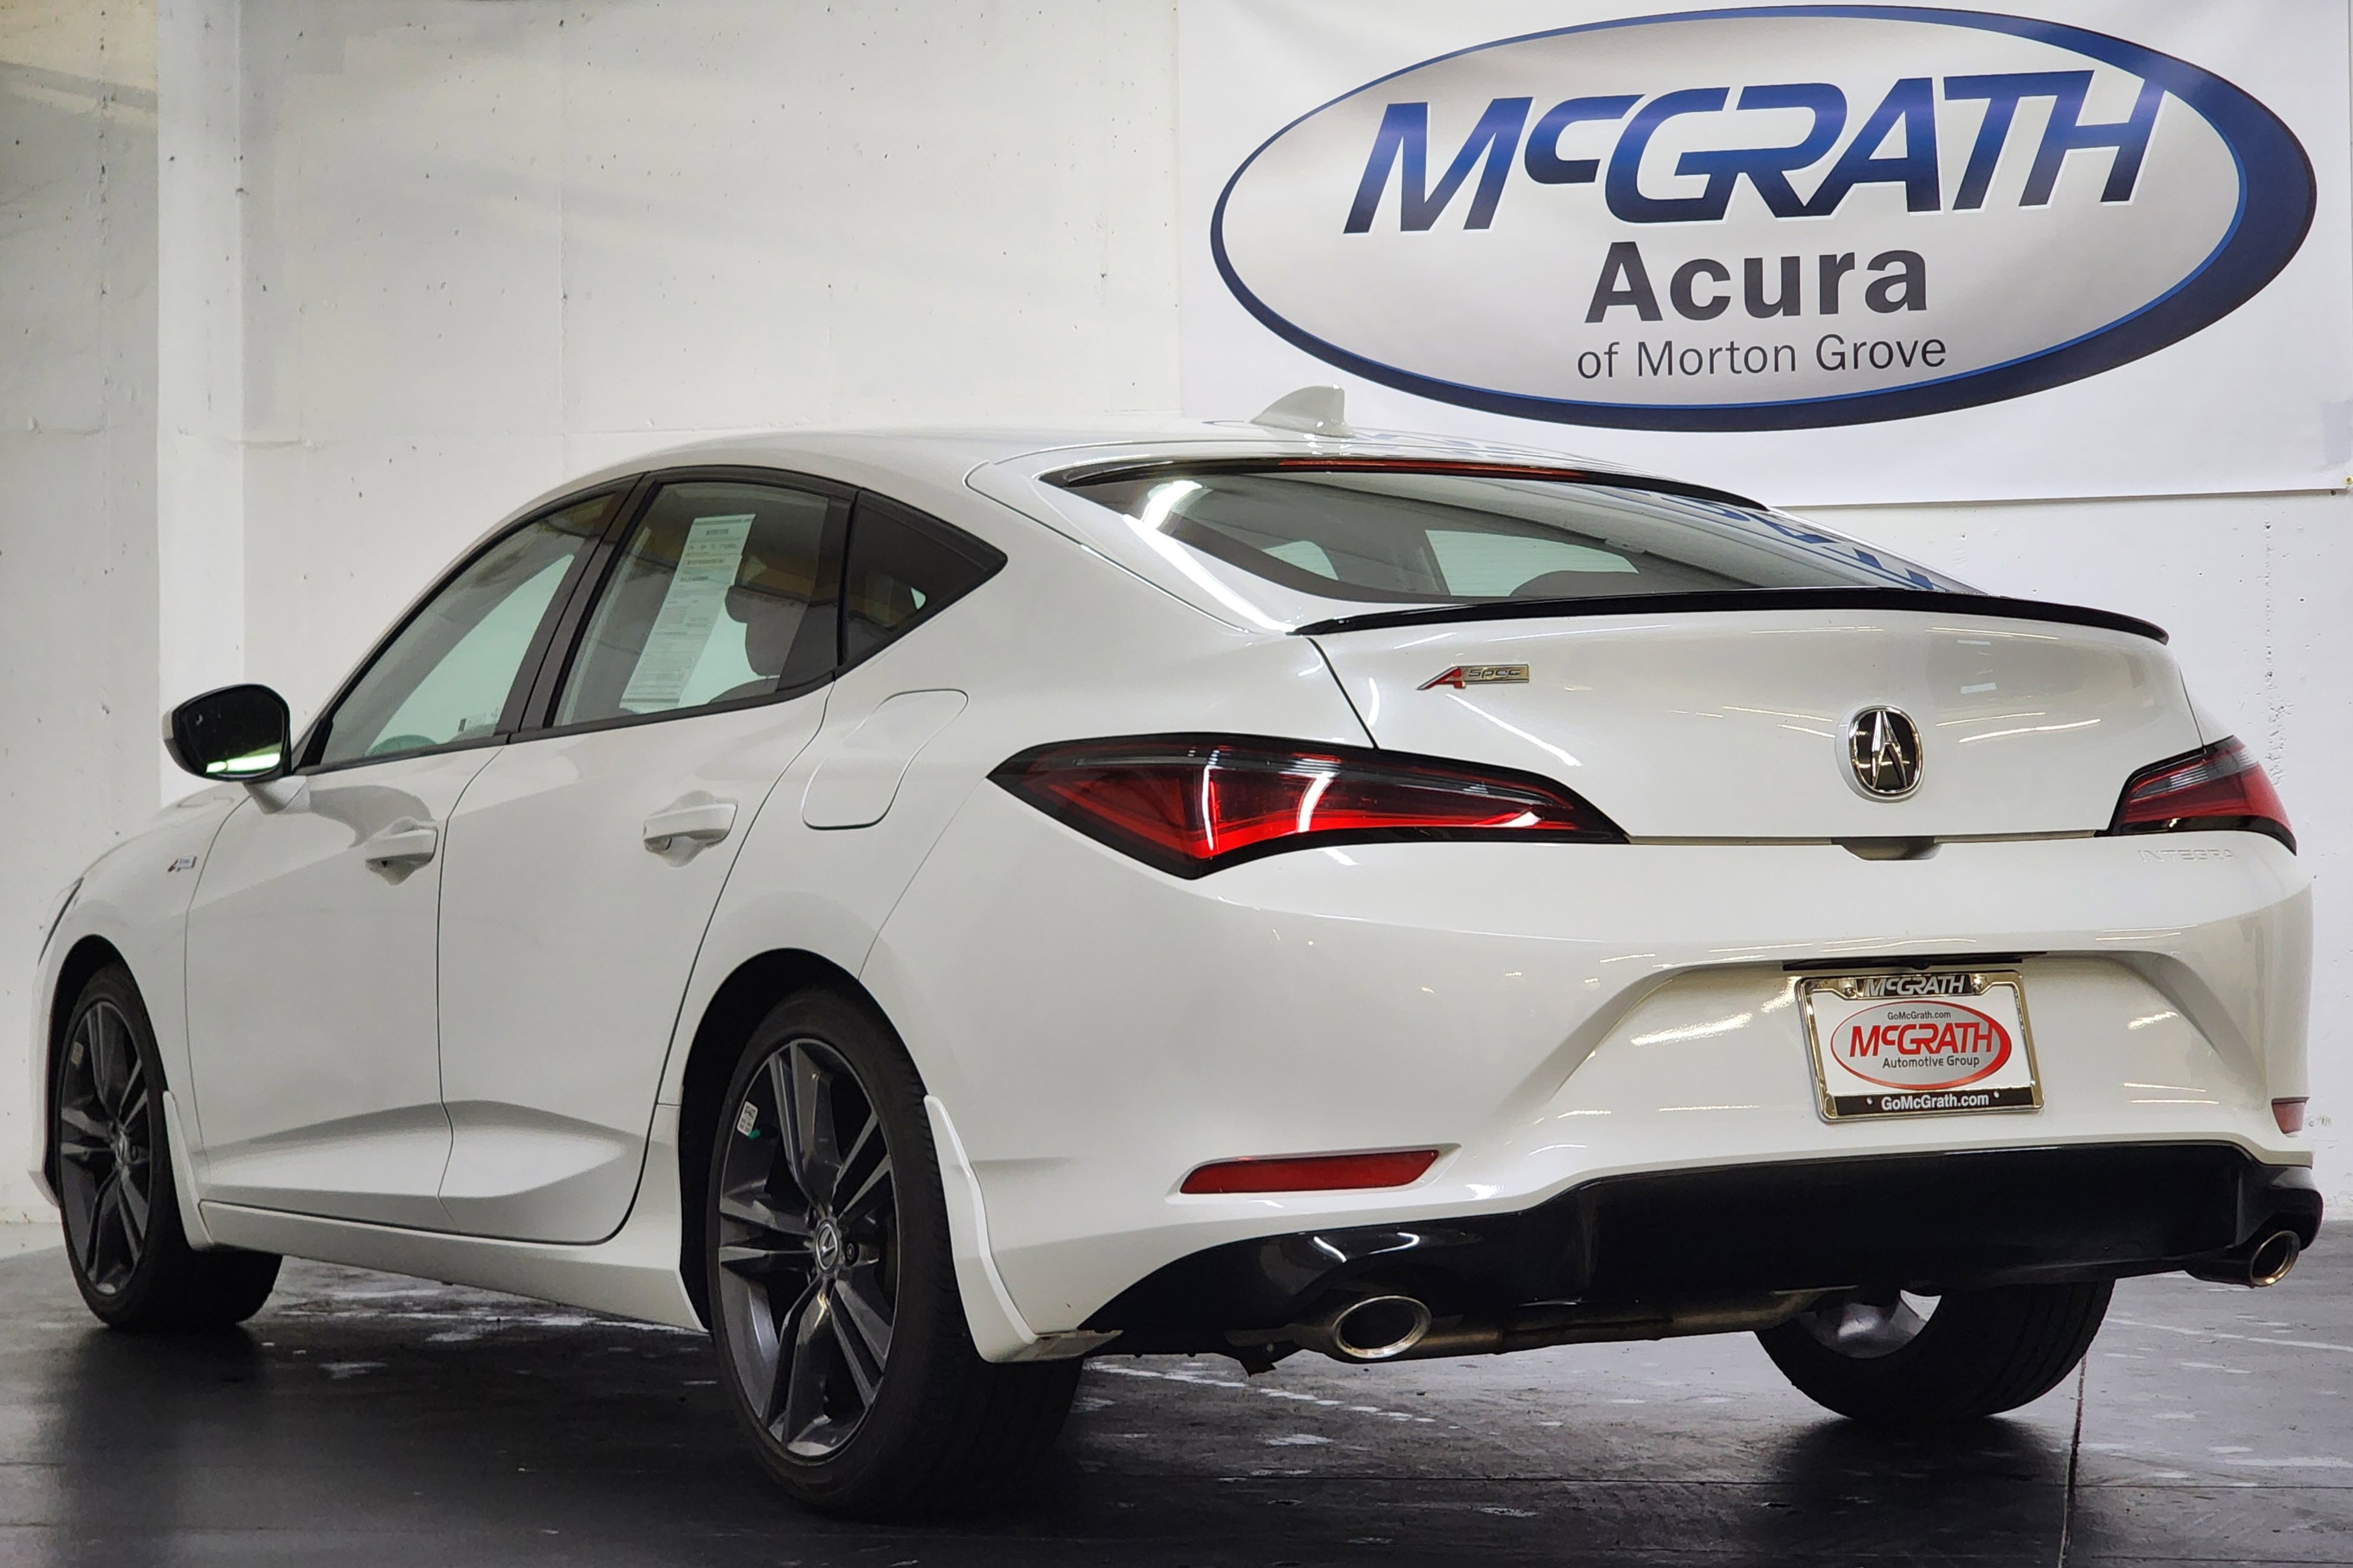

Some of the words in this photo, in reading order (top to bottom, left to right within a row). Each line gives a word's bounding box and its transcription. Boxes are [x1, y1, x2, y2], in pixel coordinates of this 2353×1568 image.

[1584, 241, 1928, 323] Acura
[1577, 341, 1620, 379] of
[1637, 340, 1797, 377] Morton
[1815, 334, 1946, 372] Grove
[2138, 849, 2239, 862] INTEGRA
[1887, 1011, 1952, 1021] GoMcGrath.com
[1882, 1056, 1944, 1068] Automotive
[1947, 1055, 1981, 1068] Group
[1881, 1094, 1989, 1111] GoMcGrath.com
